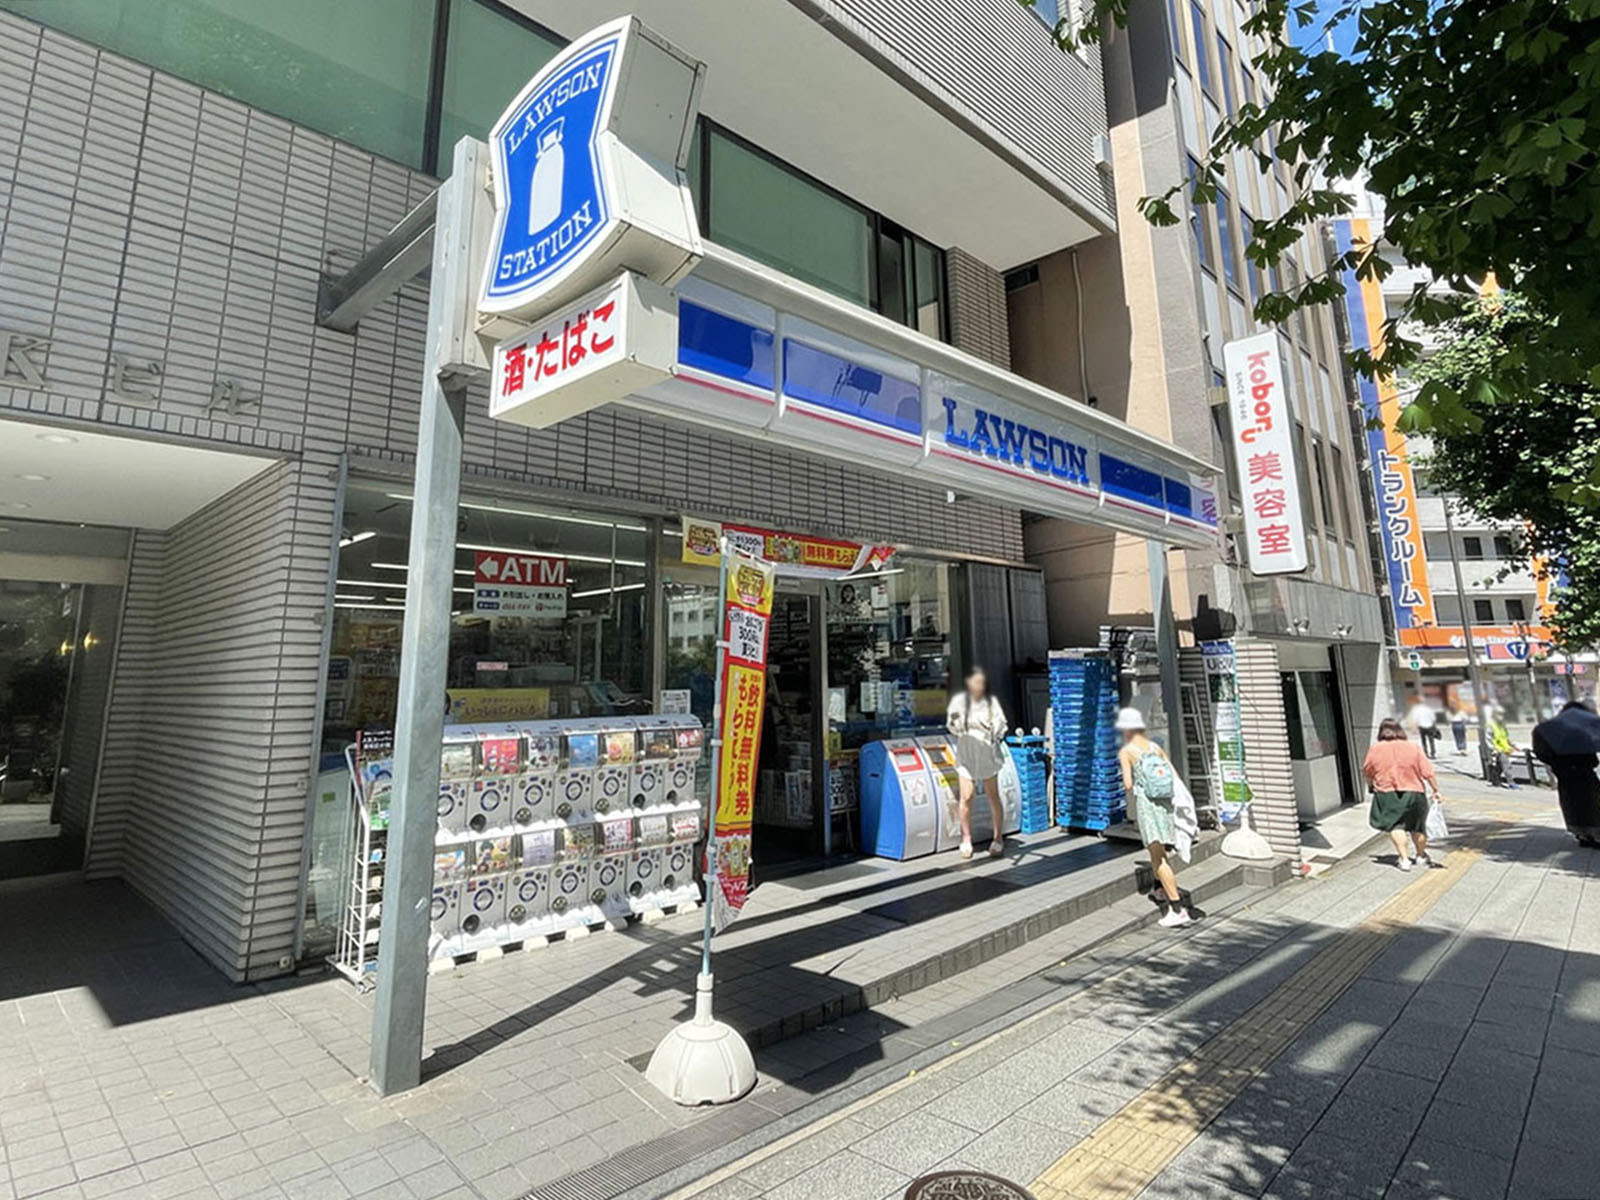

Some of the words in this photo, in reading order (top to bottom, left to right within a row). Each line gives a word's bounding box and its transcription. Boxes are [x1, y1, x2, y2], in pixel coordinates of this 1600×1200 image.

[508, 62, 603, 154] LAWSON
[499, 201, 593, 280] STATION
[502, 300, 616, 396] 酒・たばこ
[942, 397, 1091, 487] LAWSON
[1247, 451, 1293, 556] 美容室
[1378, 449, 1424, 607] トランクルーム
[499, 556, 565, 585] ATM
[1510, 643, 1527, 657] 17
[734, 684, 760, 817] 飲料無料券
